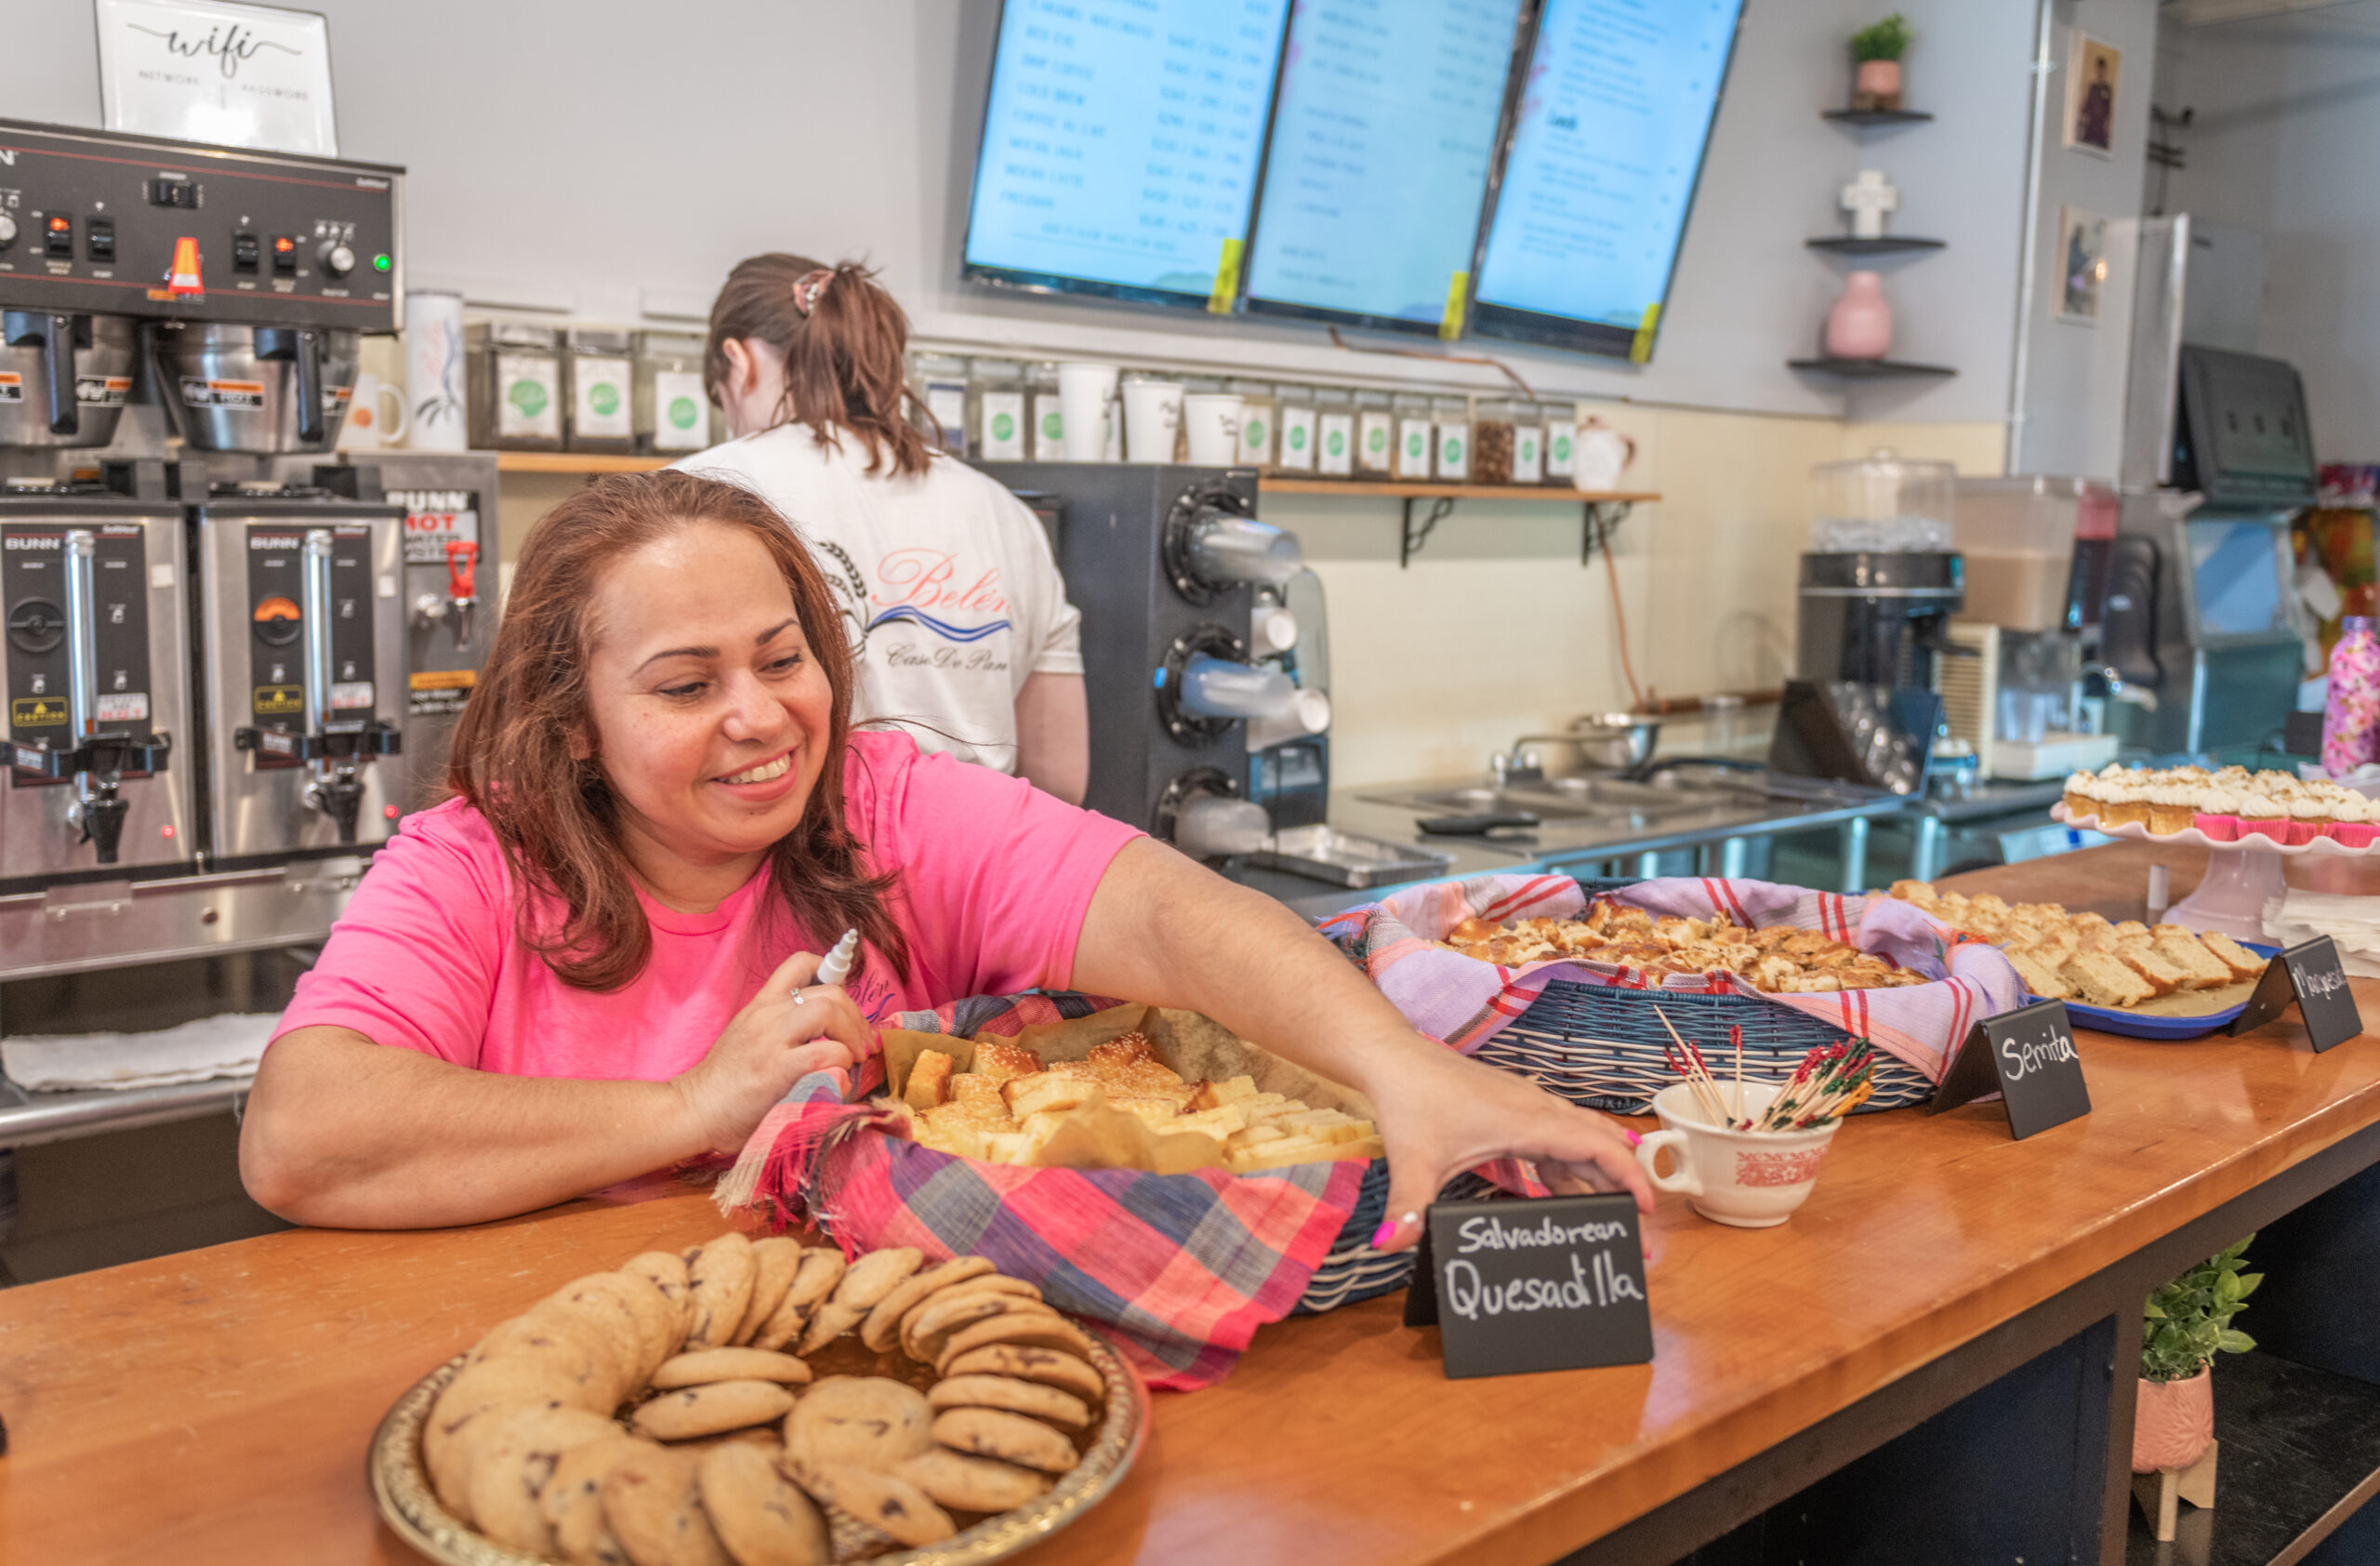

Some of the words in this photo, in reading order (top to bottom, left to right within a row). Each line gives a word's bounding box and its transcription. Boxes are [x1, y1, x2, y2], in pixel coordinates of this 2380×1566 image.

[126, 23, 303, 79] wifi
[386, 490, 469, 511] BUNN
[5, 537, 60, 551] BUNN
[250, 536, 298, 551] BUNN
[1458, 1216, 1627, 1254] Salvadorean
[1445, 1250, 1645, 1320] Quesadilla
